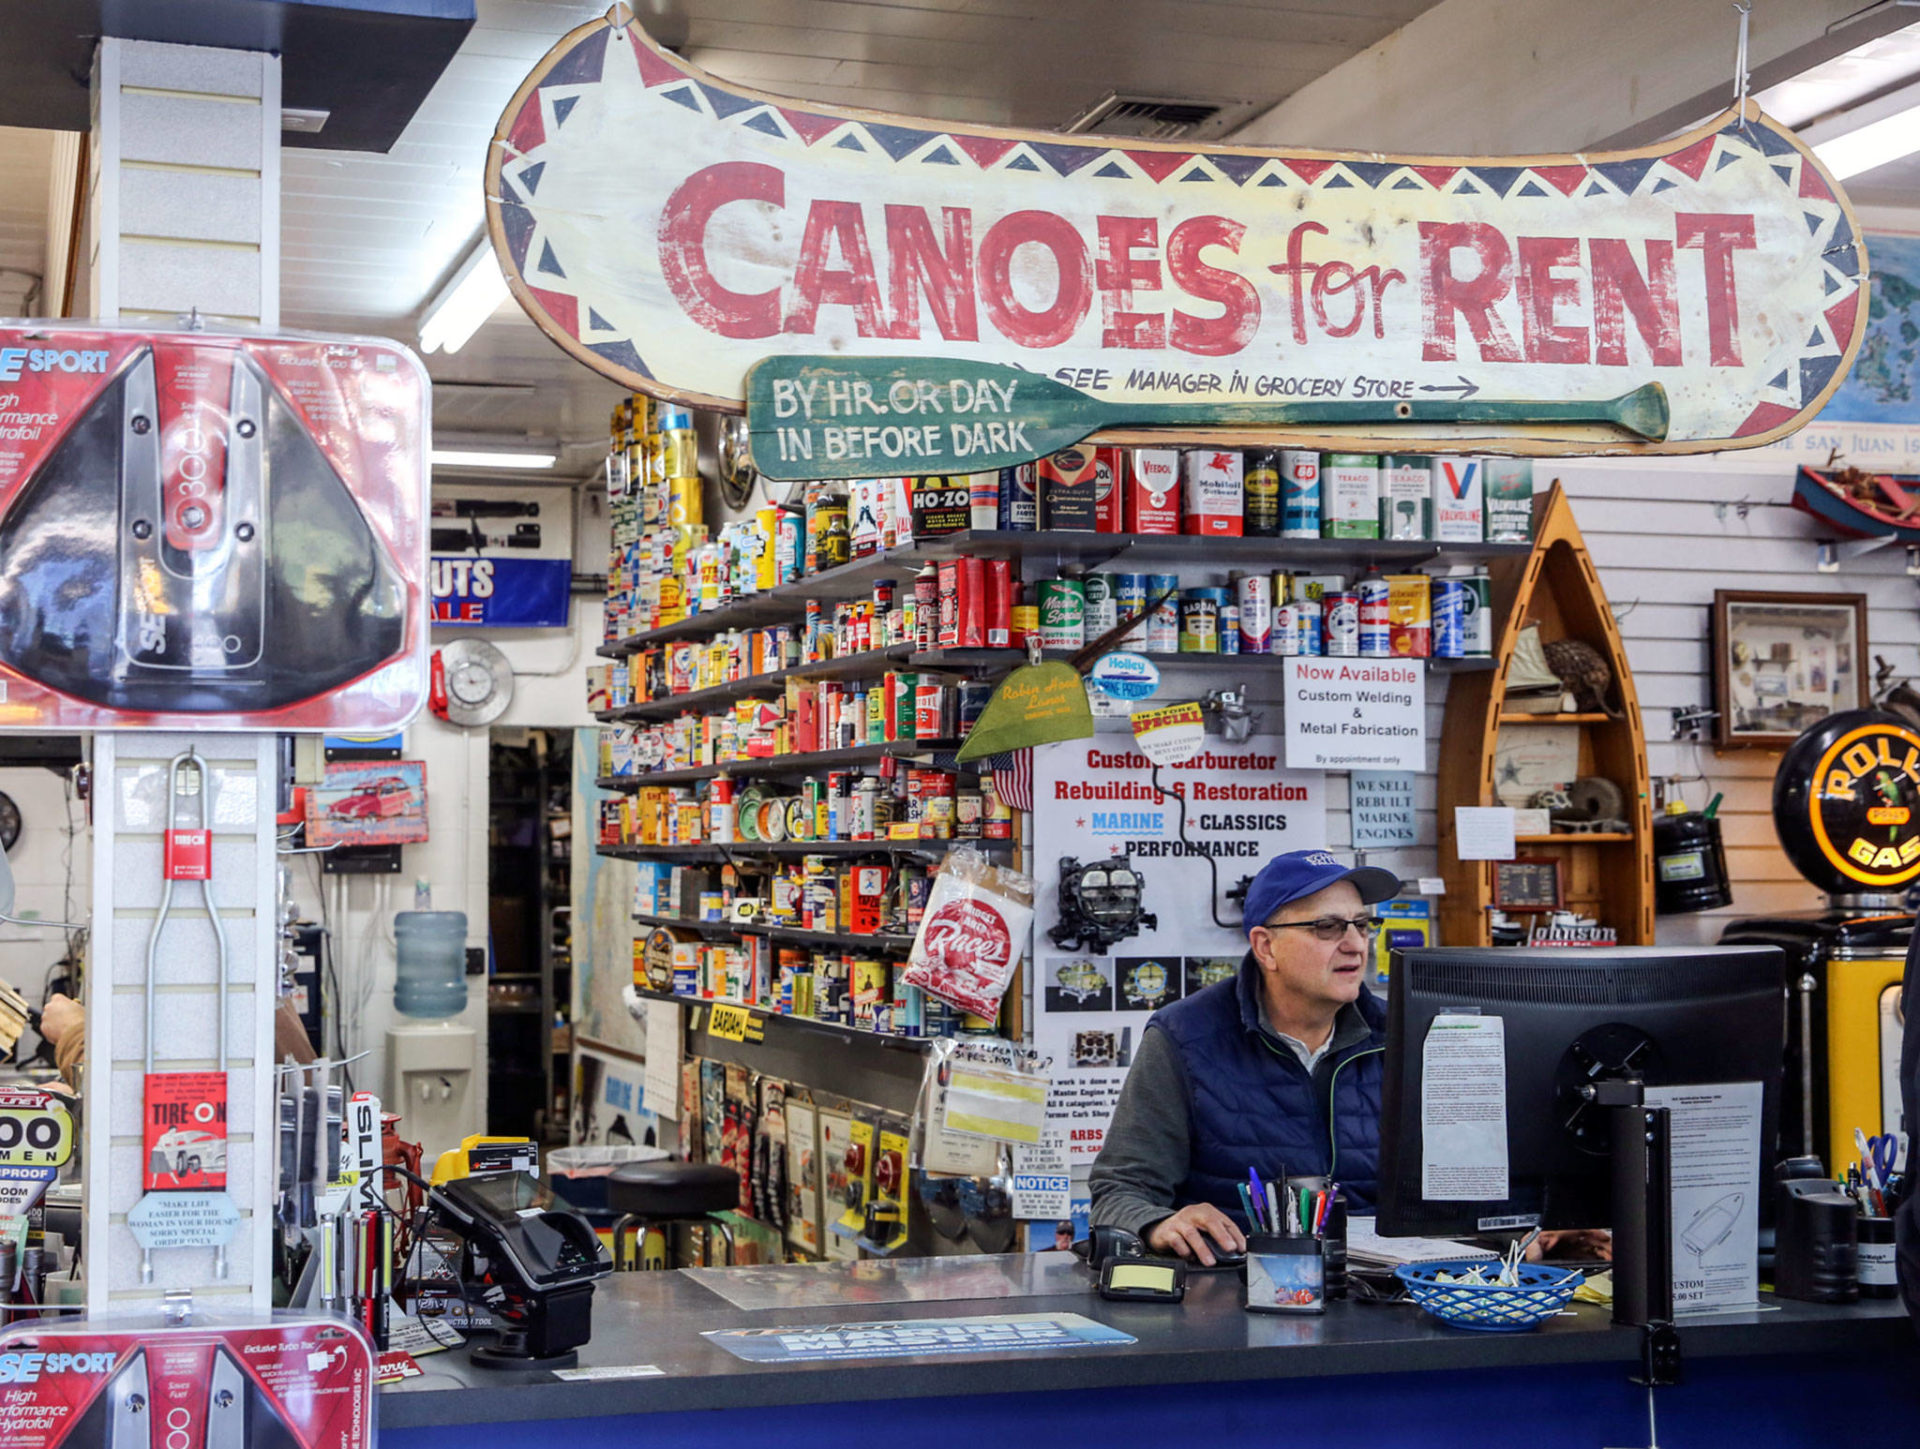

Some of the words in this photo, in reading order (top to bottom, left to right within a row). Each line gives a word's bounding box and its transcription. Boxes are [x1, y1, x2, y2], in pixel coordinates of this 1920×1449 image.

[657, 160, 1262, 357] CANOES
[1267, 220, 1406, 345] for
[1417, 211, 1757, 367] RENT
[29, 350, 109, 373] SPORT
[1055, 367, 1110, 392] SEE
[1124, 368, 1223, 393] MANAGER
[1254, 374, 1349, 398] GROCERY
[1353, 377, 1415, 400] STORE
[772, 378, 829, 418] BY
[951, 379, 1018, 414] DAY
[776, 427, 813, 462] IN
[824, 424, 942, 461] BEFORE
[952, 421, 1034, 456] DARK
[1805, 435, 1843, 450] SAN
[1852, 434, 1895, 453] JUAN
[1143, 461, 1172, 475] VEEDOL
[913, 492, 969, 509] HO-ZO
[1438, 508, 1481, 523] VALVOLINE
[1109, 658, 1144, 673] Holley
[1296, 664, 1334, 680] Now
[1338, 665, 1417, 683] Available
[1297, 689, 1351, 702] Custom
[1356, 691, 1412, 706] Welding
[1352, 707, 1363, 718] &
[1131, 710, 1204, 735] SPECIAL
[1300, 722, 1337, 735] Metal
[1341, 723, 1418, 737] Fabrication
[1316, 754, 1327, 764] By
[1329, 755, 1381, 764] appointment
[1382, 756, 1401, 765] only
[1055, 781, 1165, 803] Rebuilding
[1192, 781, 1308, 802] Restoration
[1356, 781, 1374, 791] WE
[1379, 780, 1412, 791] SELL
[1356, 797, 1413, 808] REBUILT
[1092, 813, 1164, 830] MARINE
[1200, 814, 1287, 831] CLASSICS
[1358, 812, 1410, 823] MARINE
[1356, 828, 1414, 839] ENGINES
[1124, 840, 1259, 858] PERFORMANCE
[1848, 834, 1920, 868] GAS
[928, 918, 1008, 963] Races
[1053, 1089, 1078, 1097] Master
[1080, 1088, 1105, 1098] Engine
[152, 1101, 227, 1125] TIRE-ON
[1072, 1110, 1090, 1118] Carb
[1092, 1110, 1110, 1119] Shop
[1016, 1176, 1068, 1190] NOTICE
[778, 1321, 1059, 1343] MARINE
[788, 1329, 1067, 1351] MASTER
[46, 1352, 117, 1374] SPORT
[5, 1390, 37, 1405] High
